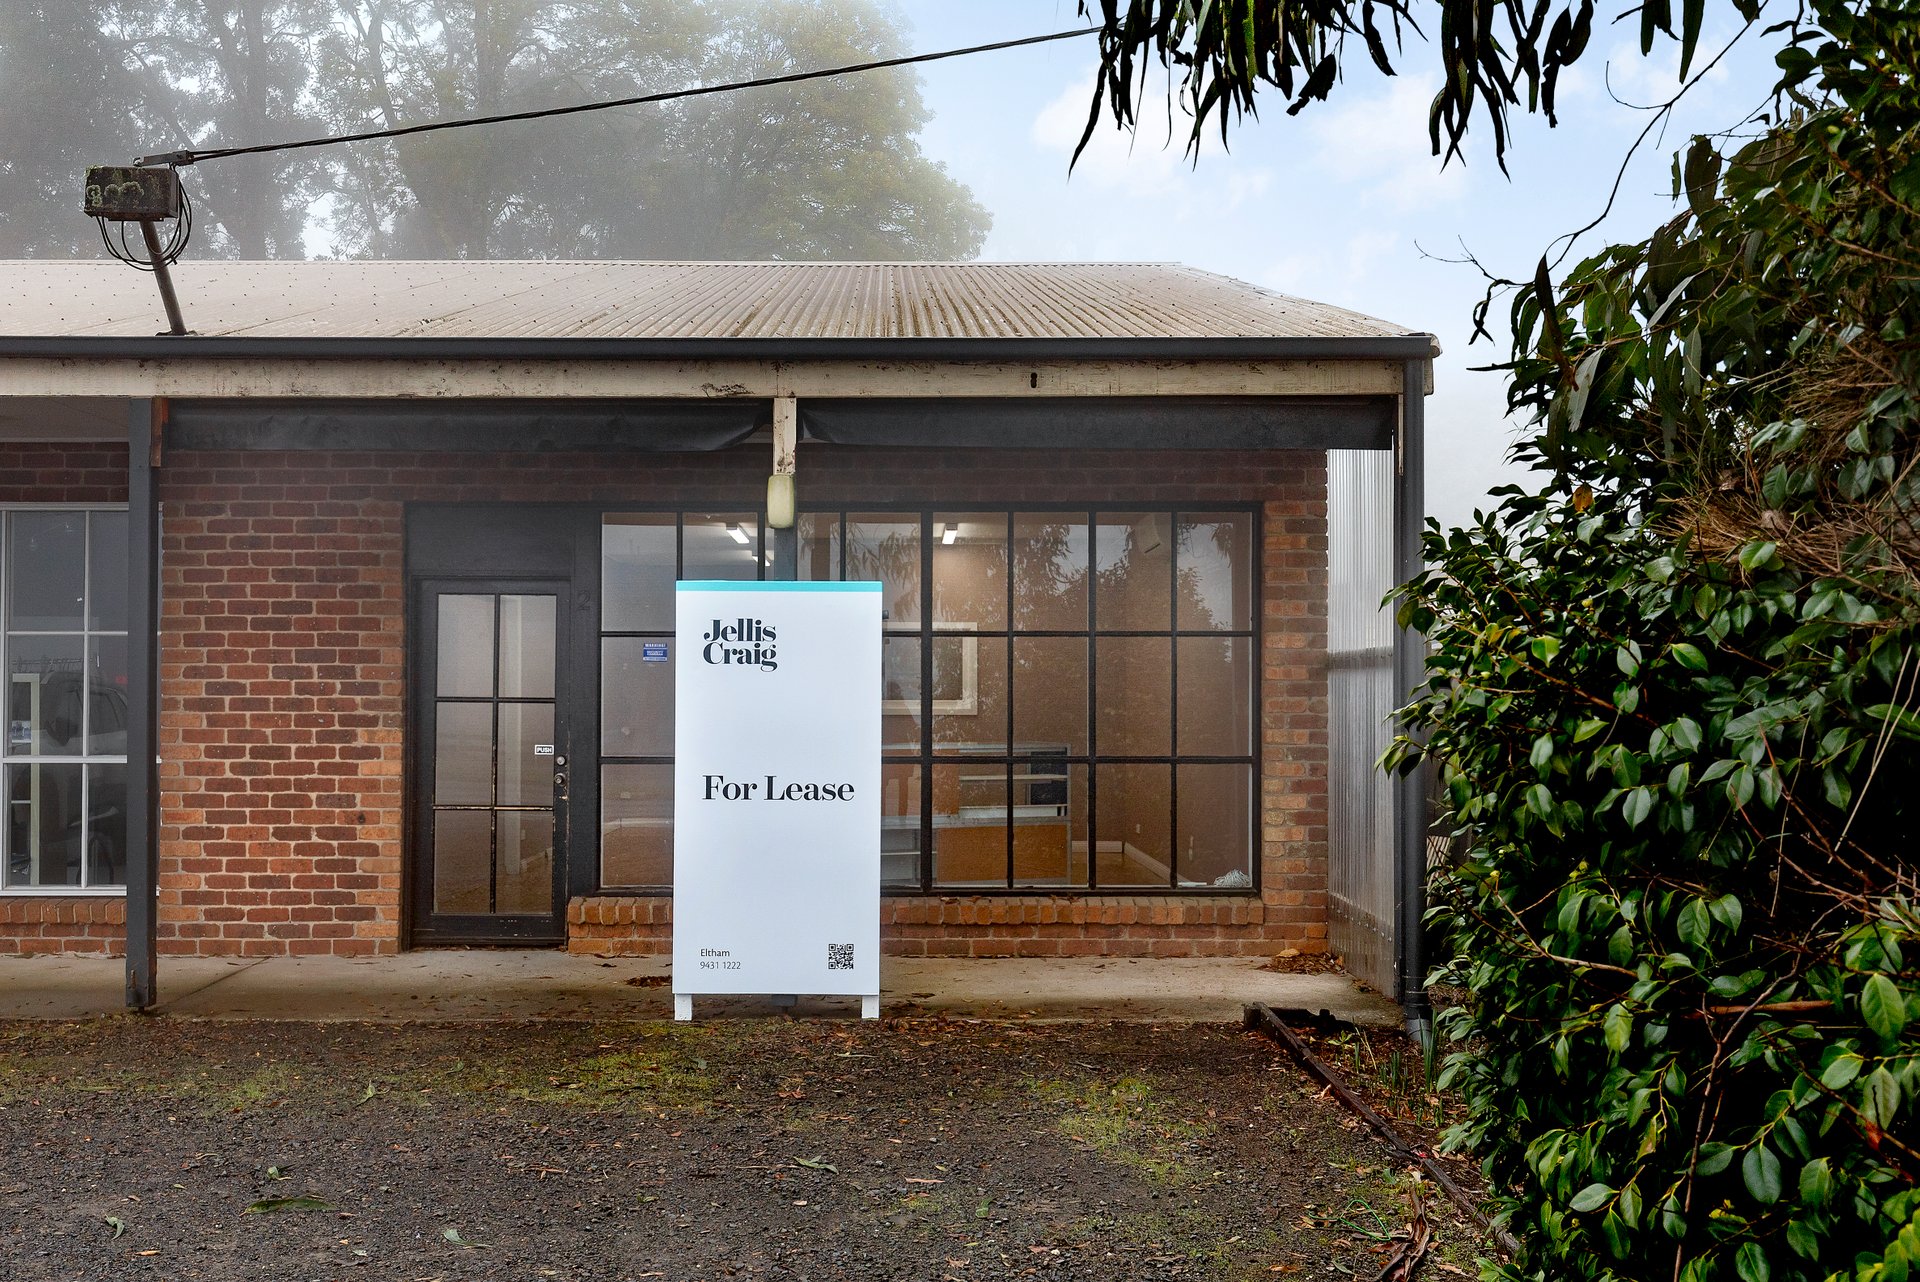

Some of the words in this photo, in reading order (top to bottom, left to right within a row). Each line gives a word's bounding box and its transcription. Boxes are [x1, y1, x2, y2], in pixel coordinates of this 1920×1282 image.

[577, 589, 591, 611] 2
[703, 618, 777, 642] Jellis
[703, 642, 778, 672] Craig
[702, 775, 758, 801] For
[763, 775, 855, 801] Lease
[700, 948, 730, 956] Eltham
[700, 961, 719, 970] 9431
[722, 961, 741, 970] 1222
